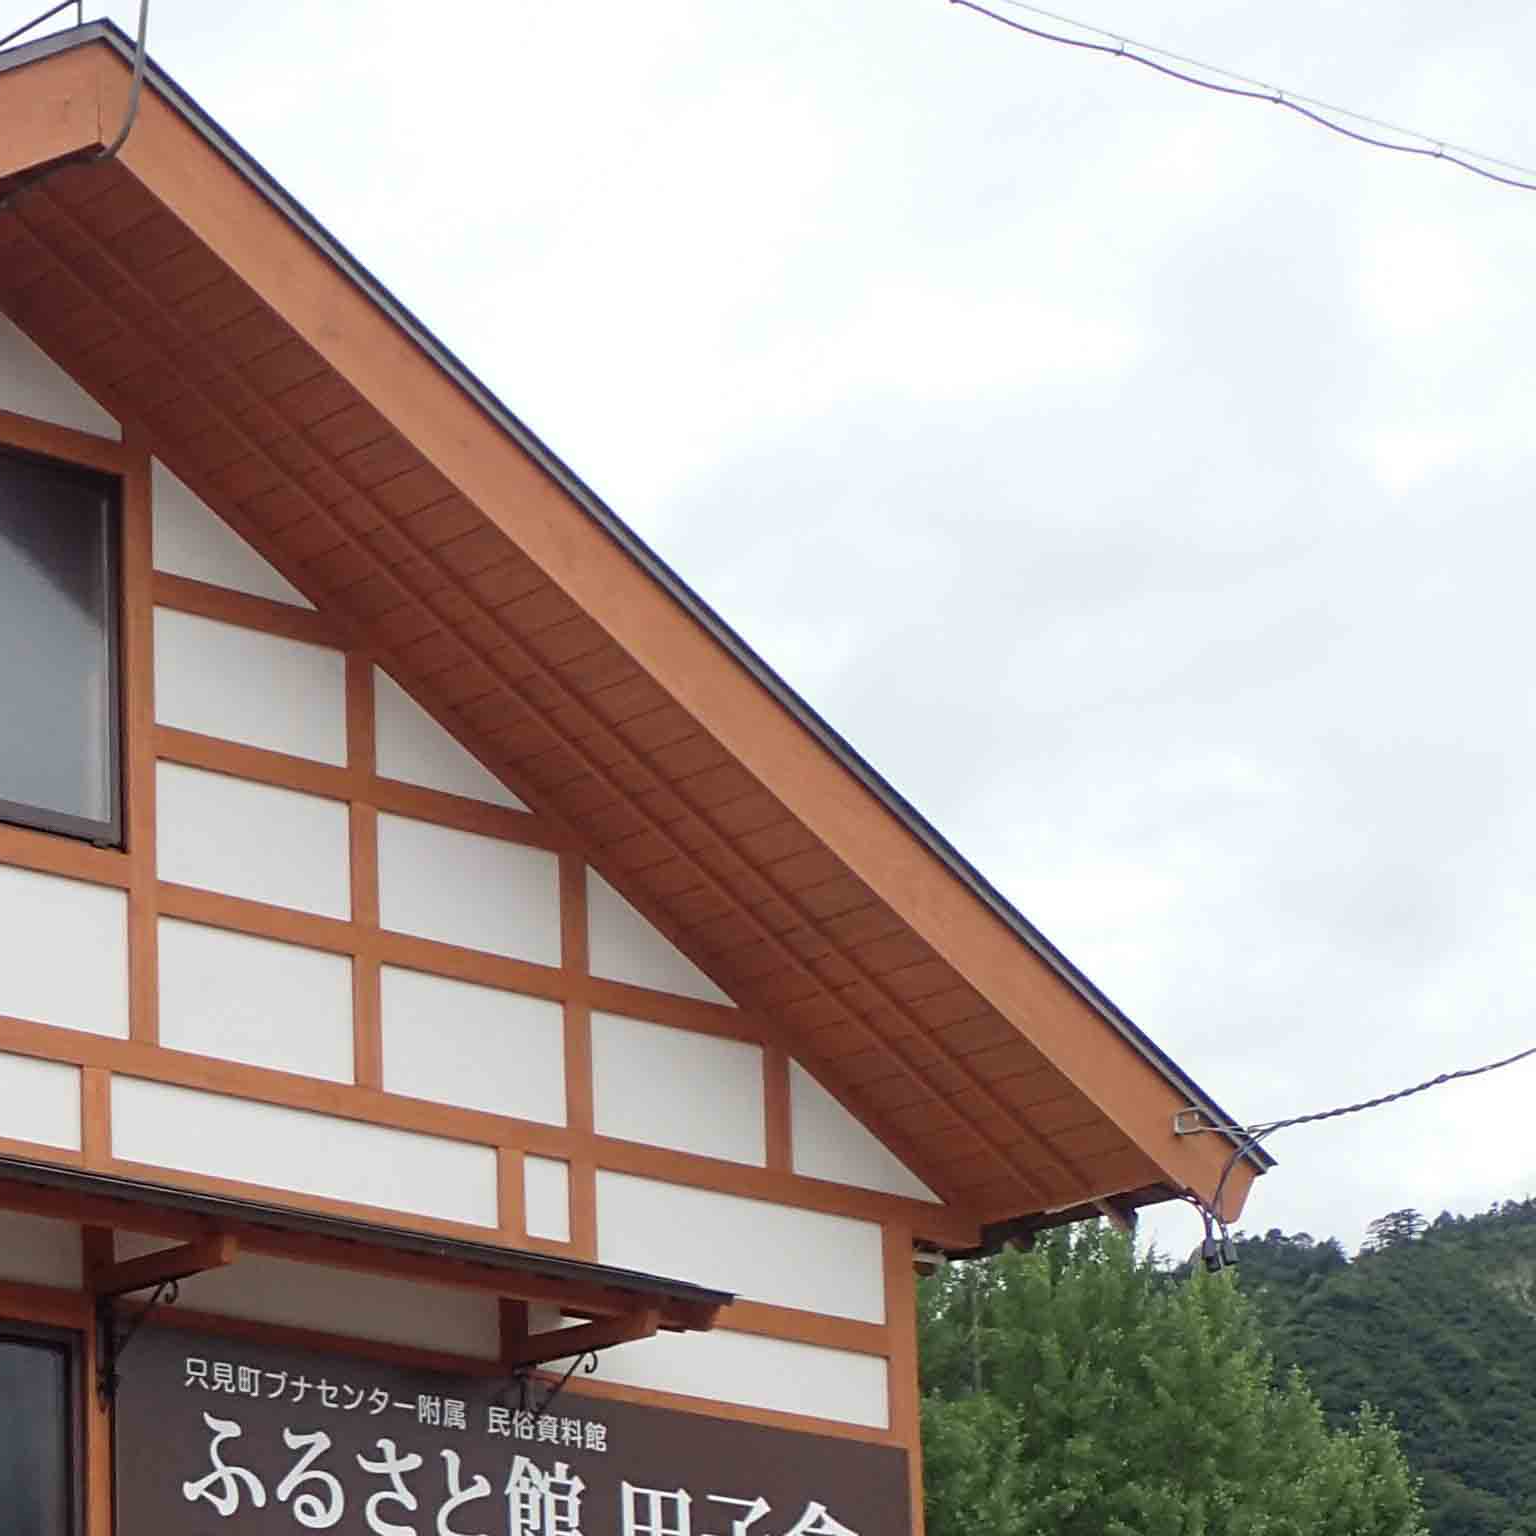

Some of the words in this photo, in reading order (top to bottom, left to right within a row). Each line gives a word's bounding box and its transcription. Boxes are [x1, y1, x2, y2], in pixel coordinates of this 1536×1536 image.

[184, 1357, 467, 1431] 只見町ブナセンター附属
[487, 1405, 609, 1453] 民俗資料館
